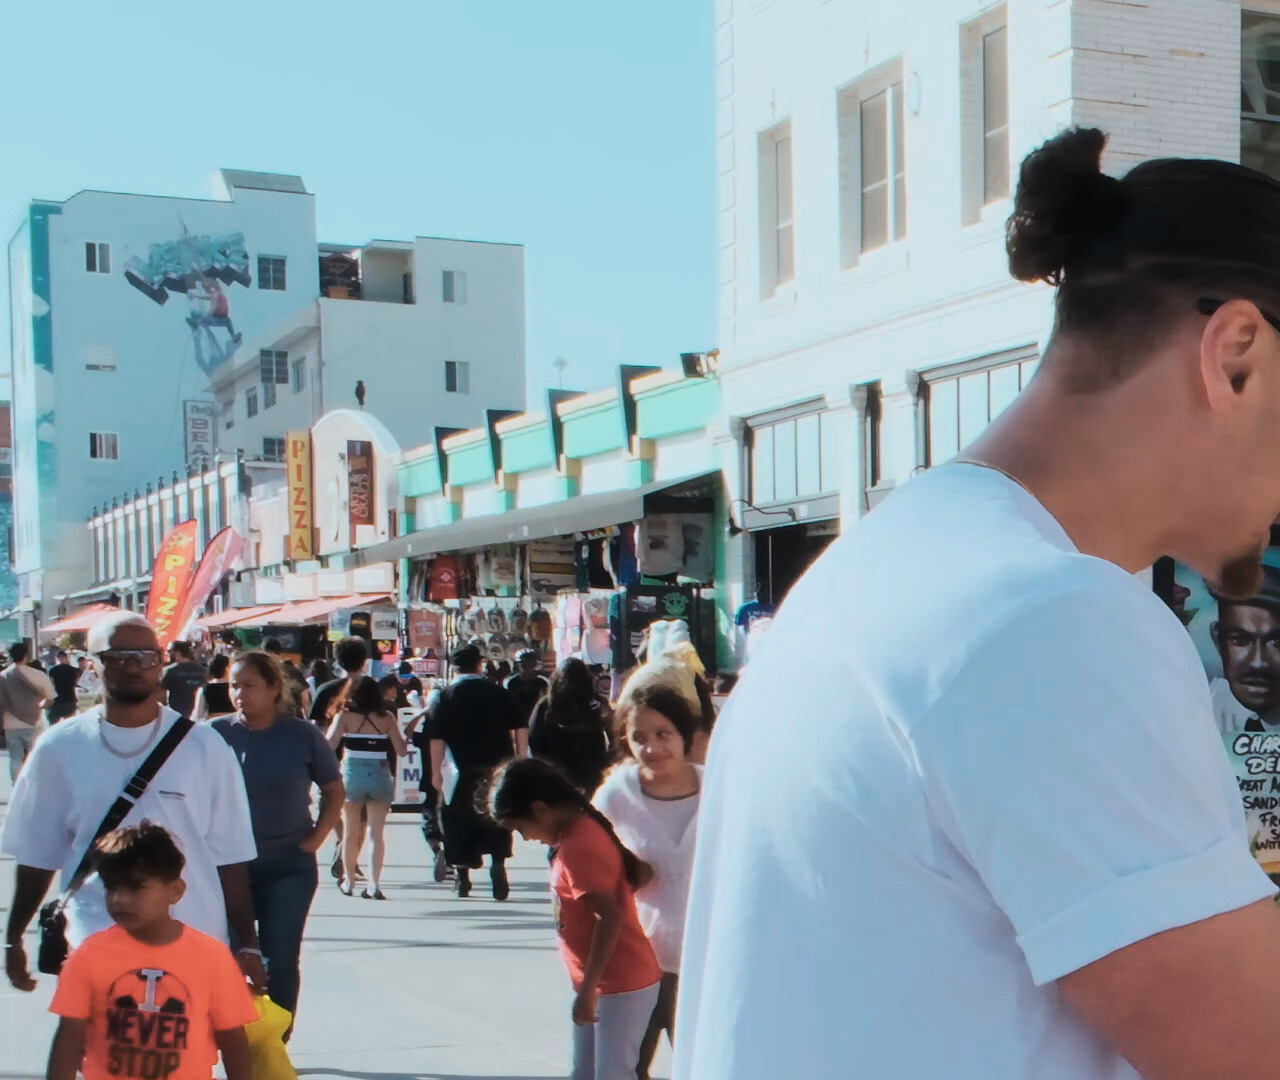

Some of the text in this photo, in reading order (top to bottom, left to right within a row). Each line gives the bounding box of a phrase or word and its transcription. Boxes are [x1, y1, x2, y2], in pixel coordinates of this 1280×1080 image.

[291, 439, 308, 553] PIZZA
[1237, 777, 1267, 793] REAT
[138, 968, 164, 1012] I
[106, 1007, 189, 1050] NEVER
[107, 1043, 181, 1080] STOP
